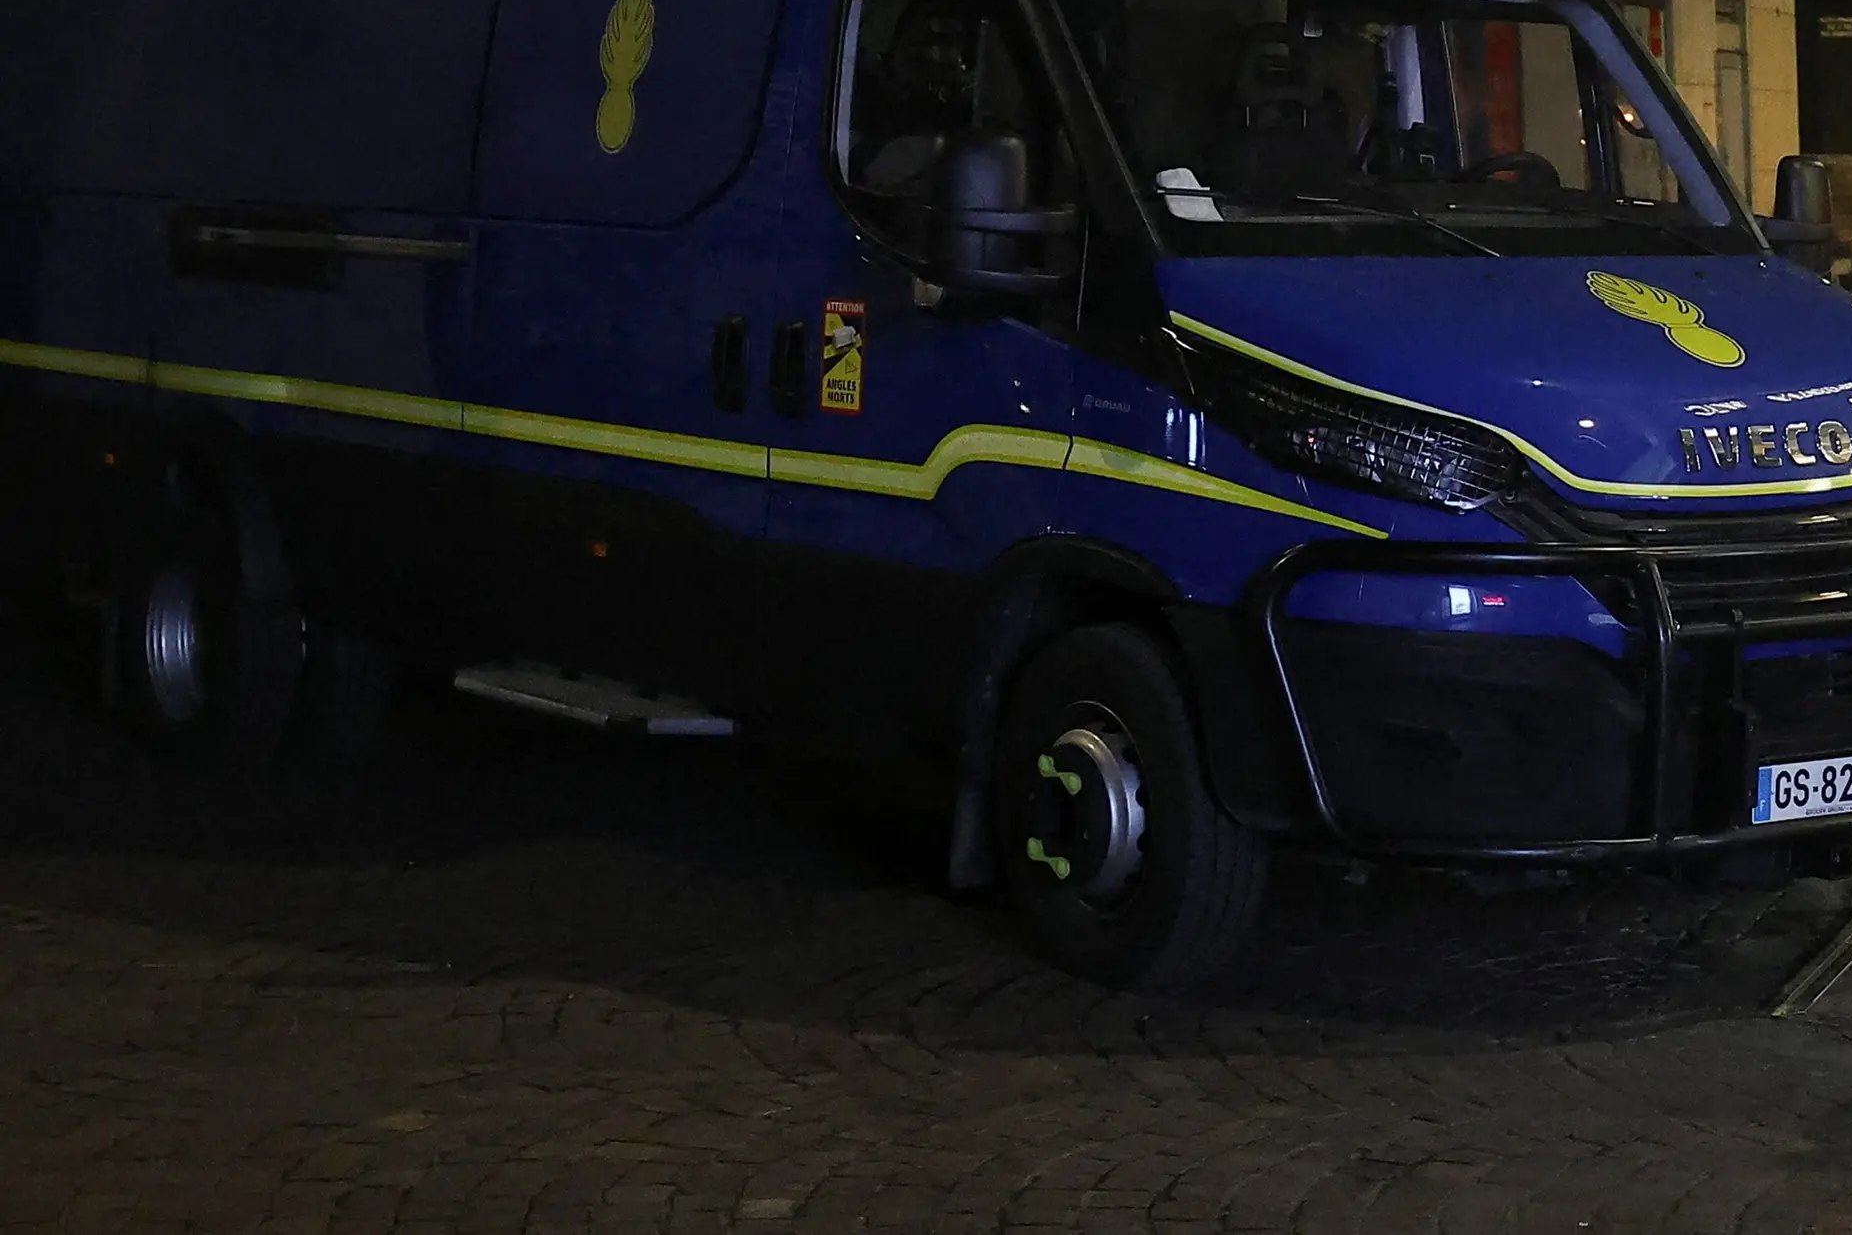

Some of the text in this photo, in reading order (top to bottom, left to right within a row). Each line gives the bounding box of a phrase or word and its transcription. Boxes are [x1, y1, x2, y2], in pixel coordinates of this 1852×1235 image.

[825, 300, 865, 314] ATTENTION
[826, 377, 857, 392] ANGLES
[827, 391, 855, 405] MORTS
